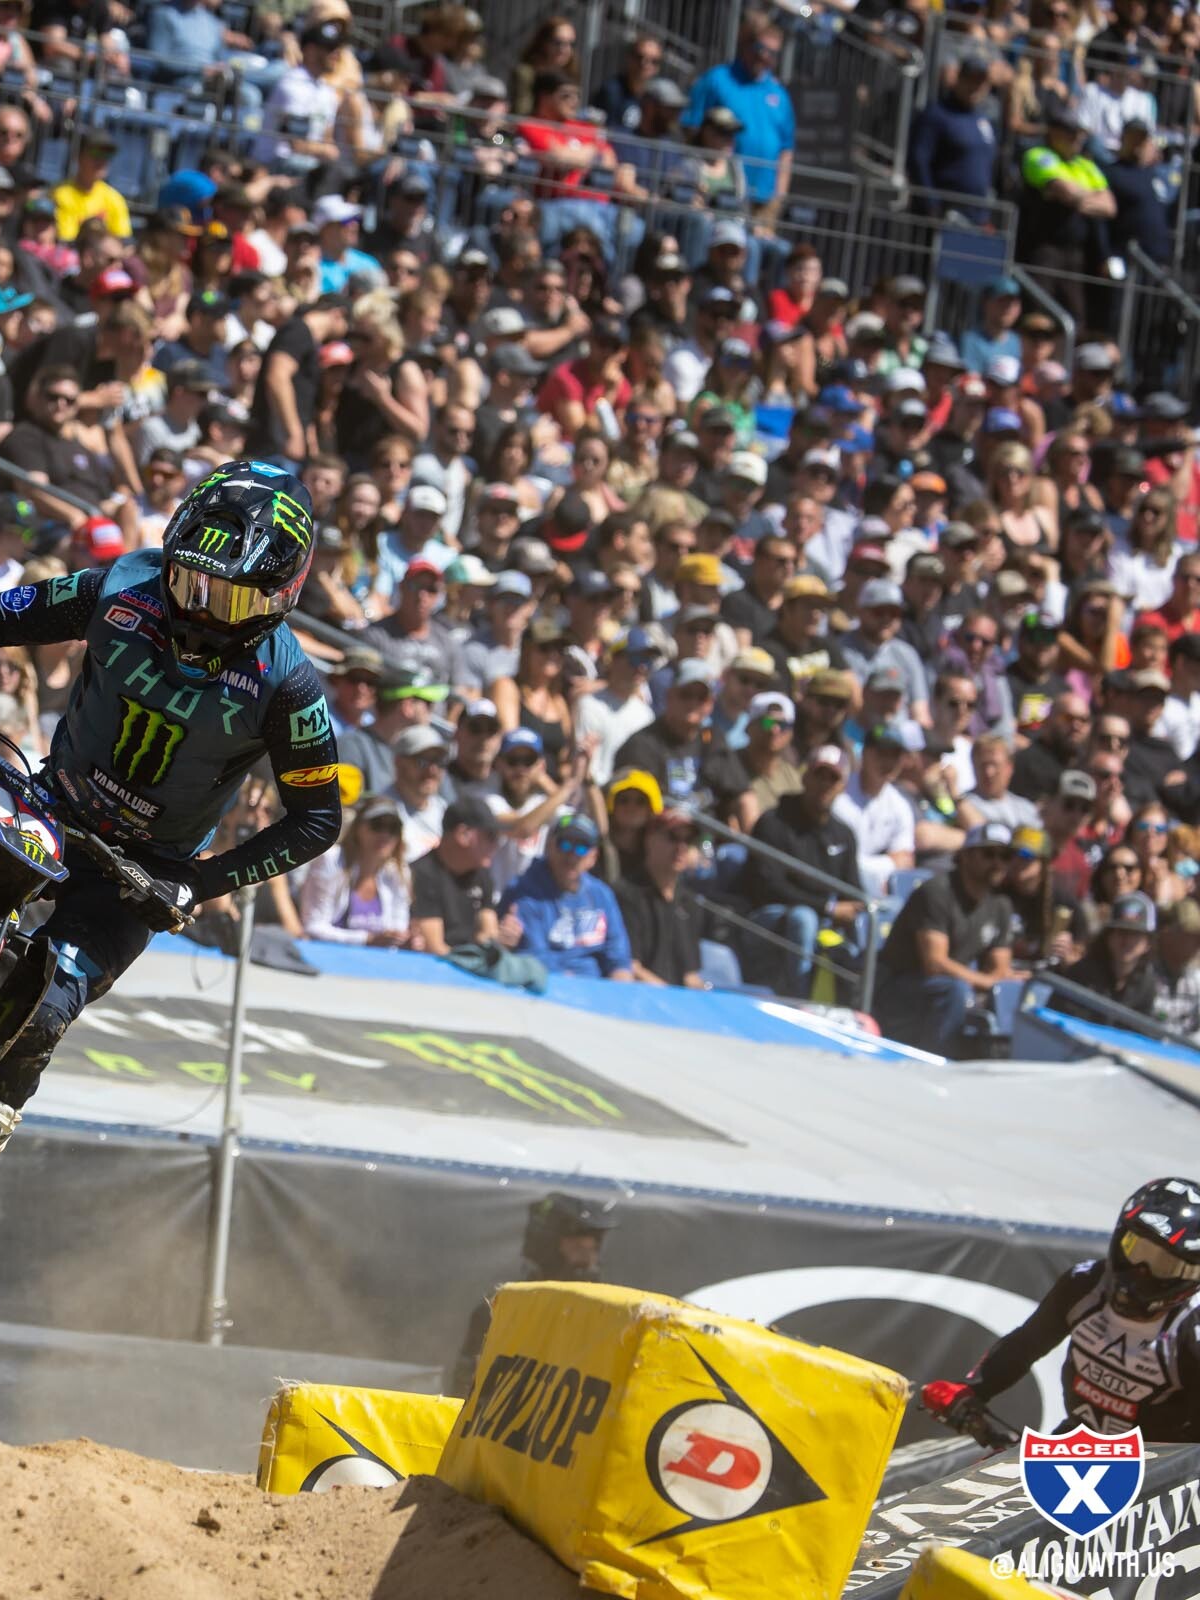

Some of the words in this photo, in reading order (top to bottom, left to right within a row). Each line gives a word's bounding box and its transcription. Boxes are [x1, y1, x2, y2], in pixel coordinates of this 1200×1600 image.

[174, 549, 227, 571] MONSTER
[219, 670, 260, 699] AMAHA
[297, 703, 327, 737] MX
[93, 768, 159, 819] YAMALUBE
[121, 865, 150, 889] ARC
[1075, 1381, 1135, 1418] MOTUL
[665, 1431, 762, 1491] D
